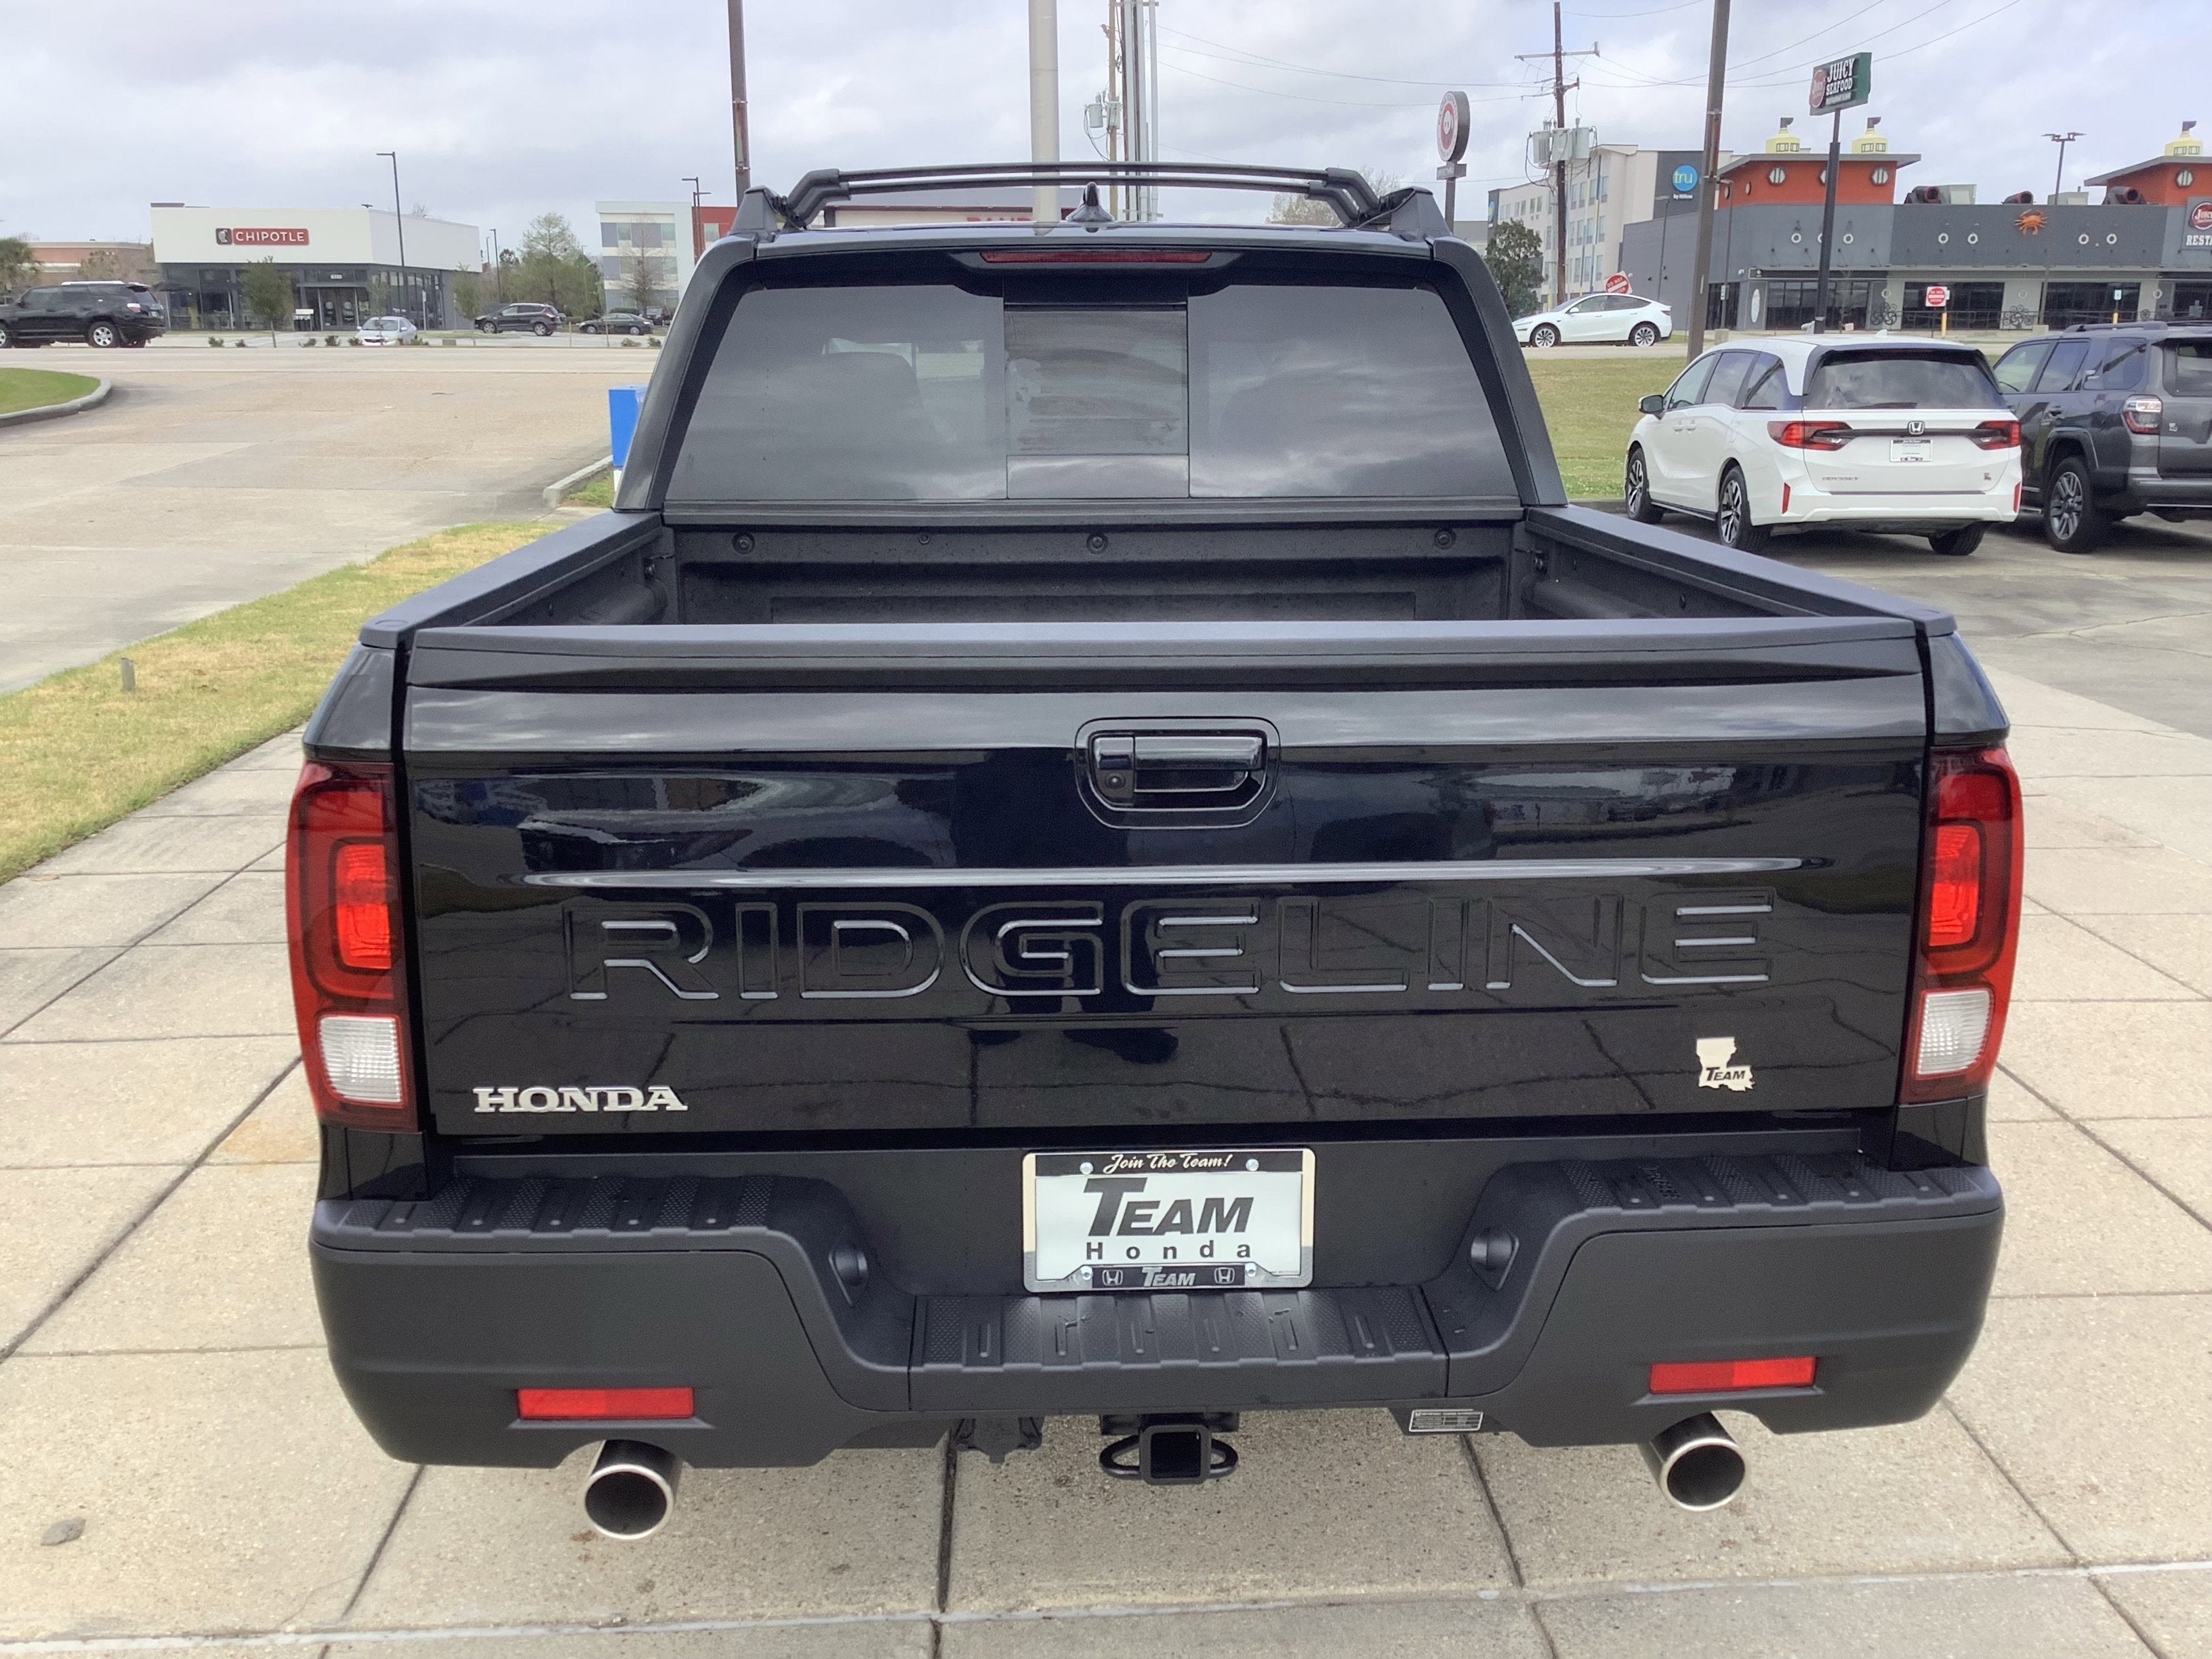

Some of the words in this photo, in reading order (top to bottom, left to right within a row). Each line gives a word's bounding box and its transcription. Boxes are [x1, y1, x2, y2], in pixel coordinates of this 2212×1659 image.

[1827, 58, 1855, 83] JUICY
[1826, 77, 1853, 96] SEAFOOD
[1674, 171, 1693, 184] tru
[236, 232, 305, 241] CHIPOTLE
[563, 886, 1775, 999] RIDGELINE
[1705, 1067, 1746, 1082] TEAM
[472, 1086, 689, 1113] HONDA
[1103, 1153, 1145, 1174] Join
[1147, 1154, 1178, 1169] The
[1179, 1153, 1233, 1169] Team!
[1083, 1176, 1254, 1237] TEAM
[1086, 1240, 1252, 1261] Honda
[1141, 1267, 1196, 1287] TEAM
